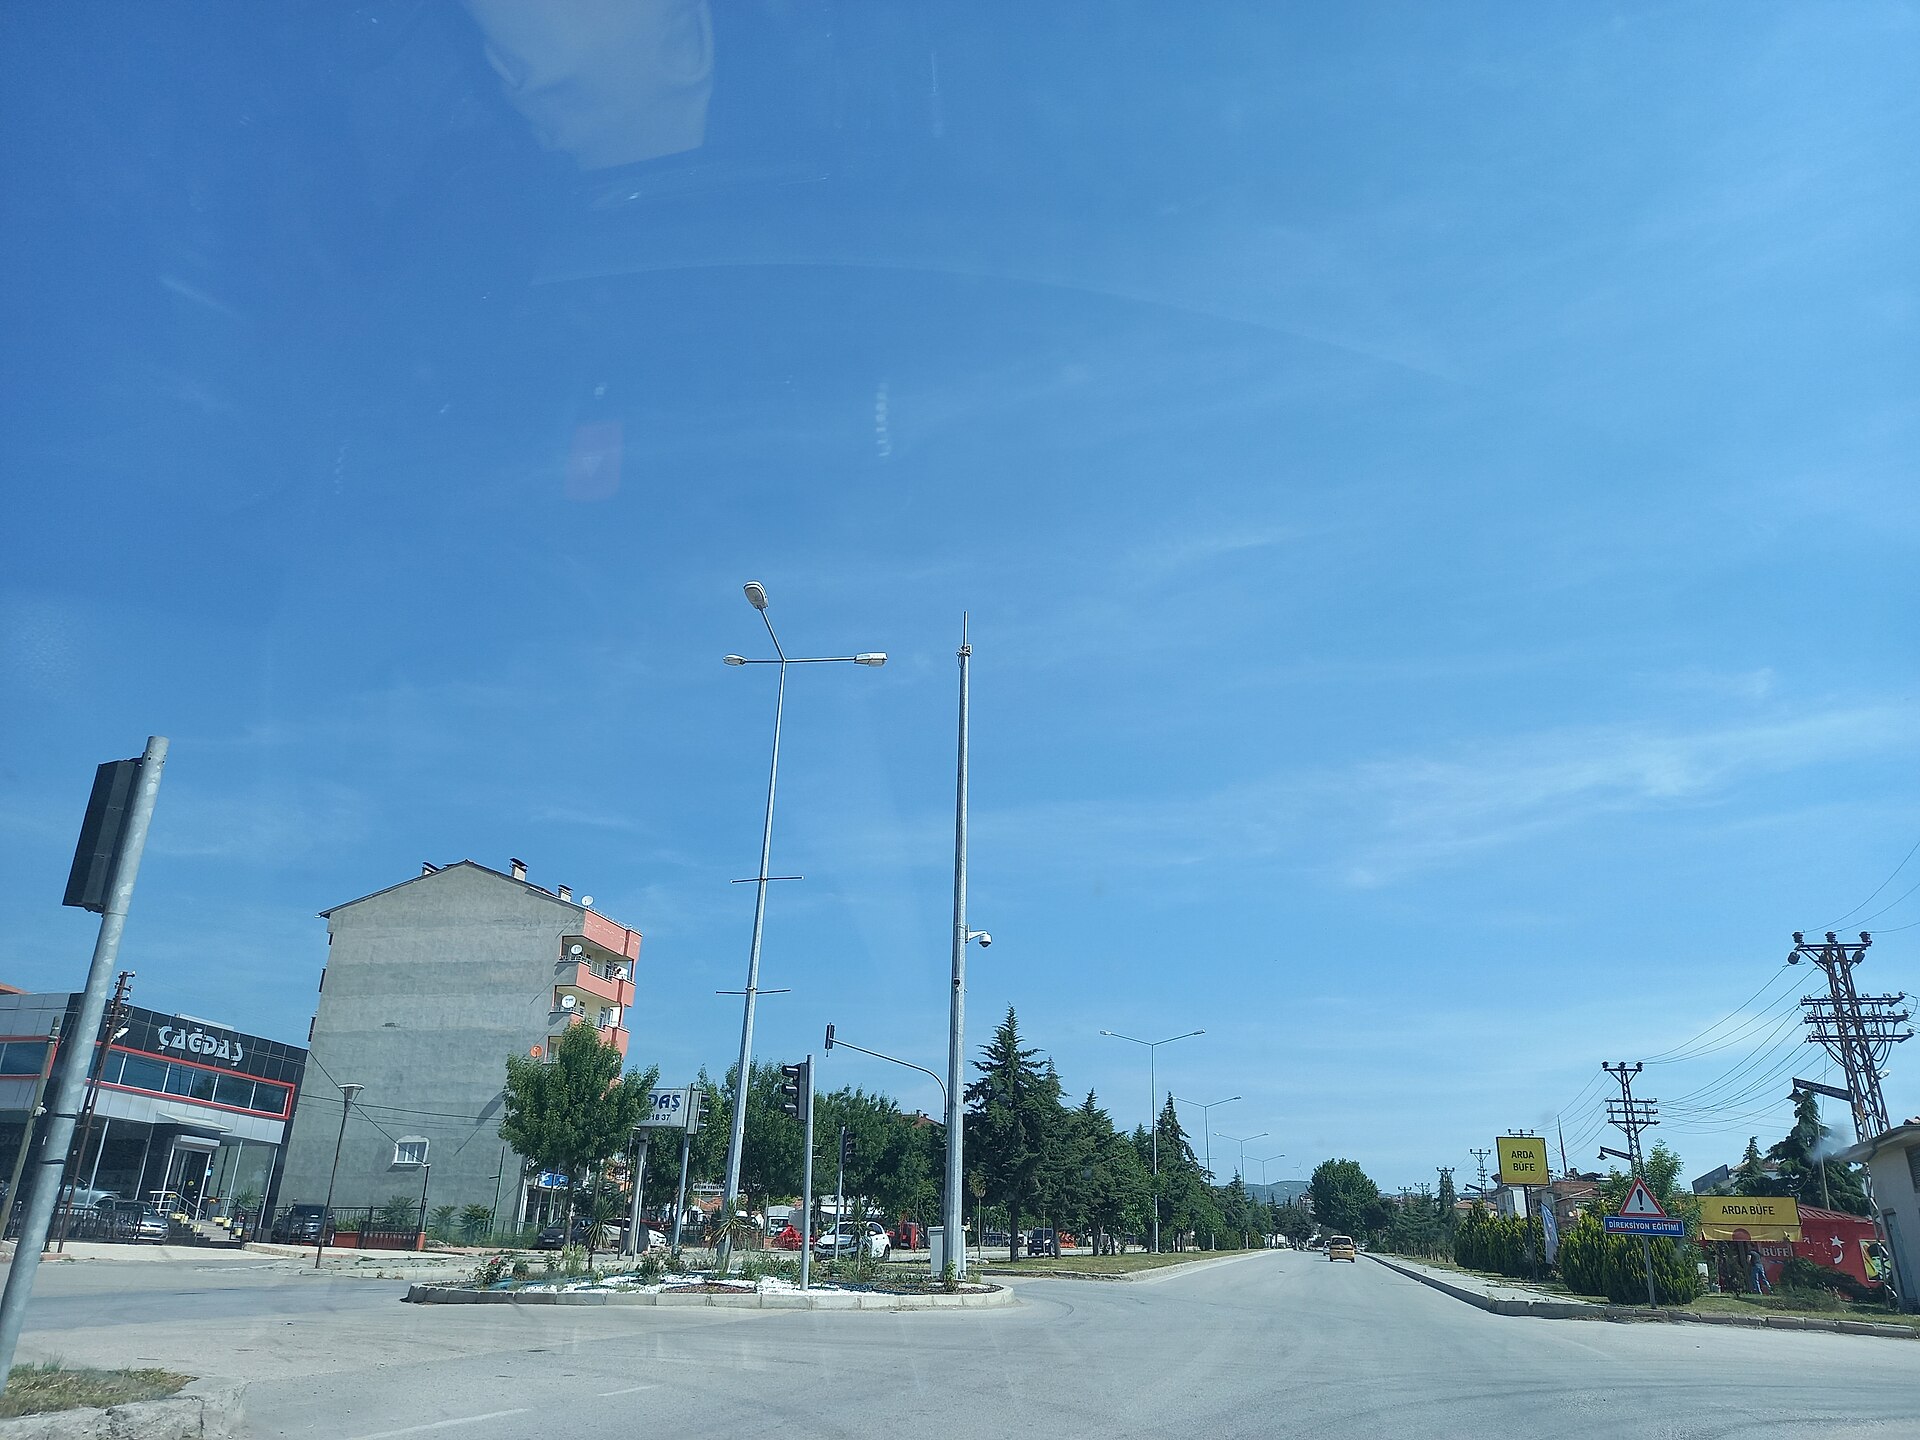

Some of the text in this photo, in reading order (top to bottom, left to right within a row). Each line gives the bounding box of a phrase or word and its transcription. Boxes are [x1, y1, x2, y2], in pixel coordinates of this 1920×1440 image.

[158, 1025, 244, 1067] ÇAĞDAŞ
[647, 1094, 681, 1112] DAŞ
[1511, 1150, 1535, 1159] ARDA
[1513, 1160, 1536, 1172] BÜFE
[1721, 1203, 1775, 1216] ARDA BÜFE
[1608, 1219, 1680, 1231] DİREKSİYON EĞİTİMİ
[1762, 1245, 1790, 1258] BÜFE
